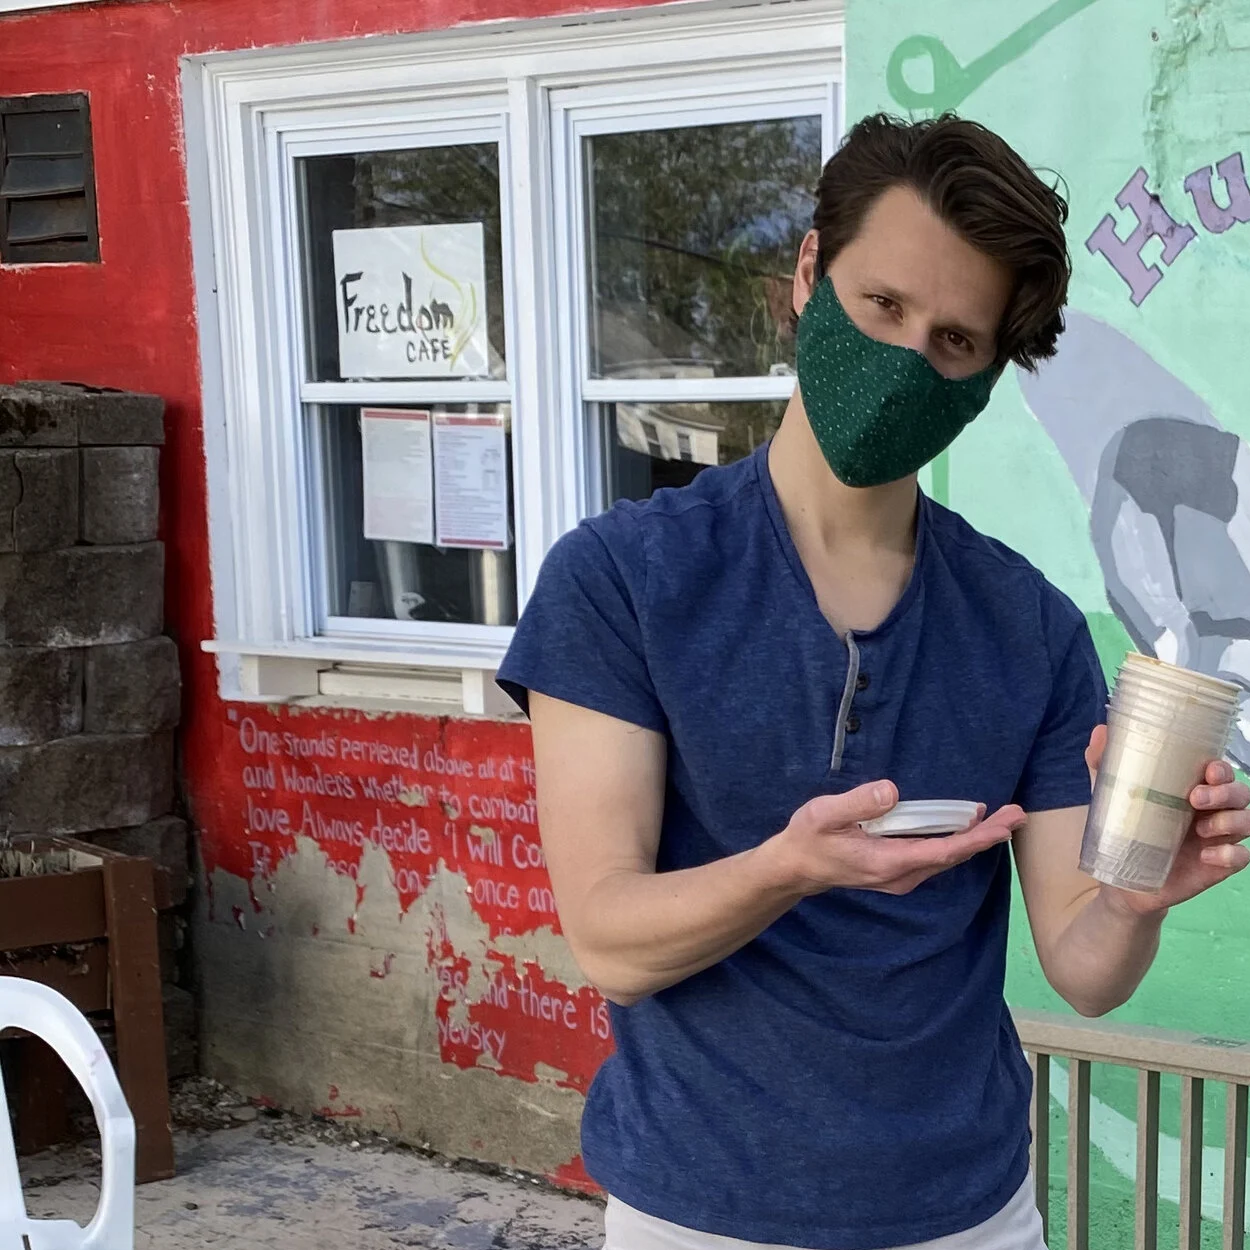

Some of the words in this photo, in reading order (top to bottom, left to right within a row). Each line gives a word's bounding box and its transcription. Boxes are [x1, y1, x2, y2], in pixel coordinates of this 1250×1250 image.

[339, 271, 454, 334] Freedom
[406, 337, 453, 363] CAFE
[340, 738, 419, 771] perplexed
[423, 743, 475, 778] above
[477, 756, 495, 780] all
[499, 755, 516, 783] at
[242, 760, 276, 790] and
[438, 783, 463, 820] to
[247, 795, 292, 836] love
[300, 799, 365, 848] Always
[369, 807, 432, 855] decide
[474, 878, 520, 909] once
[519, 974, 578, 1030] there
